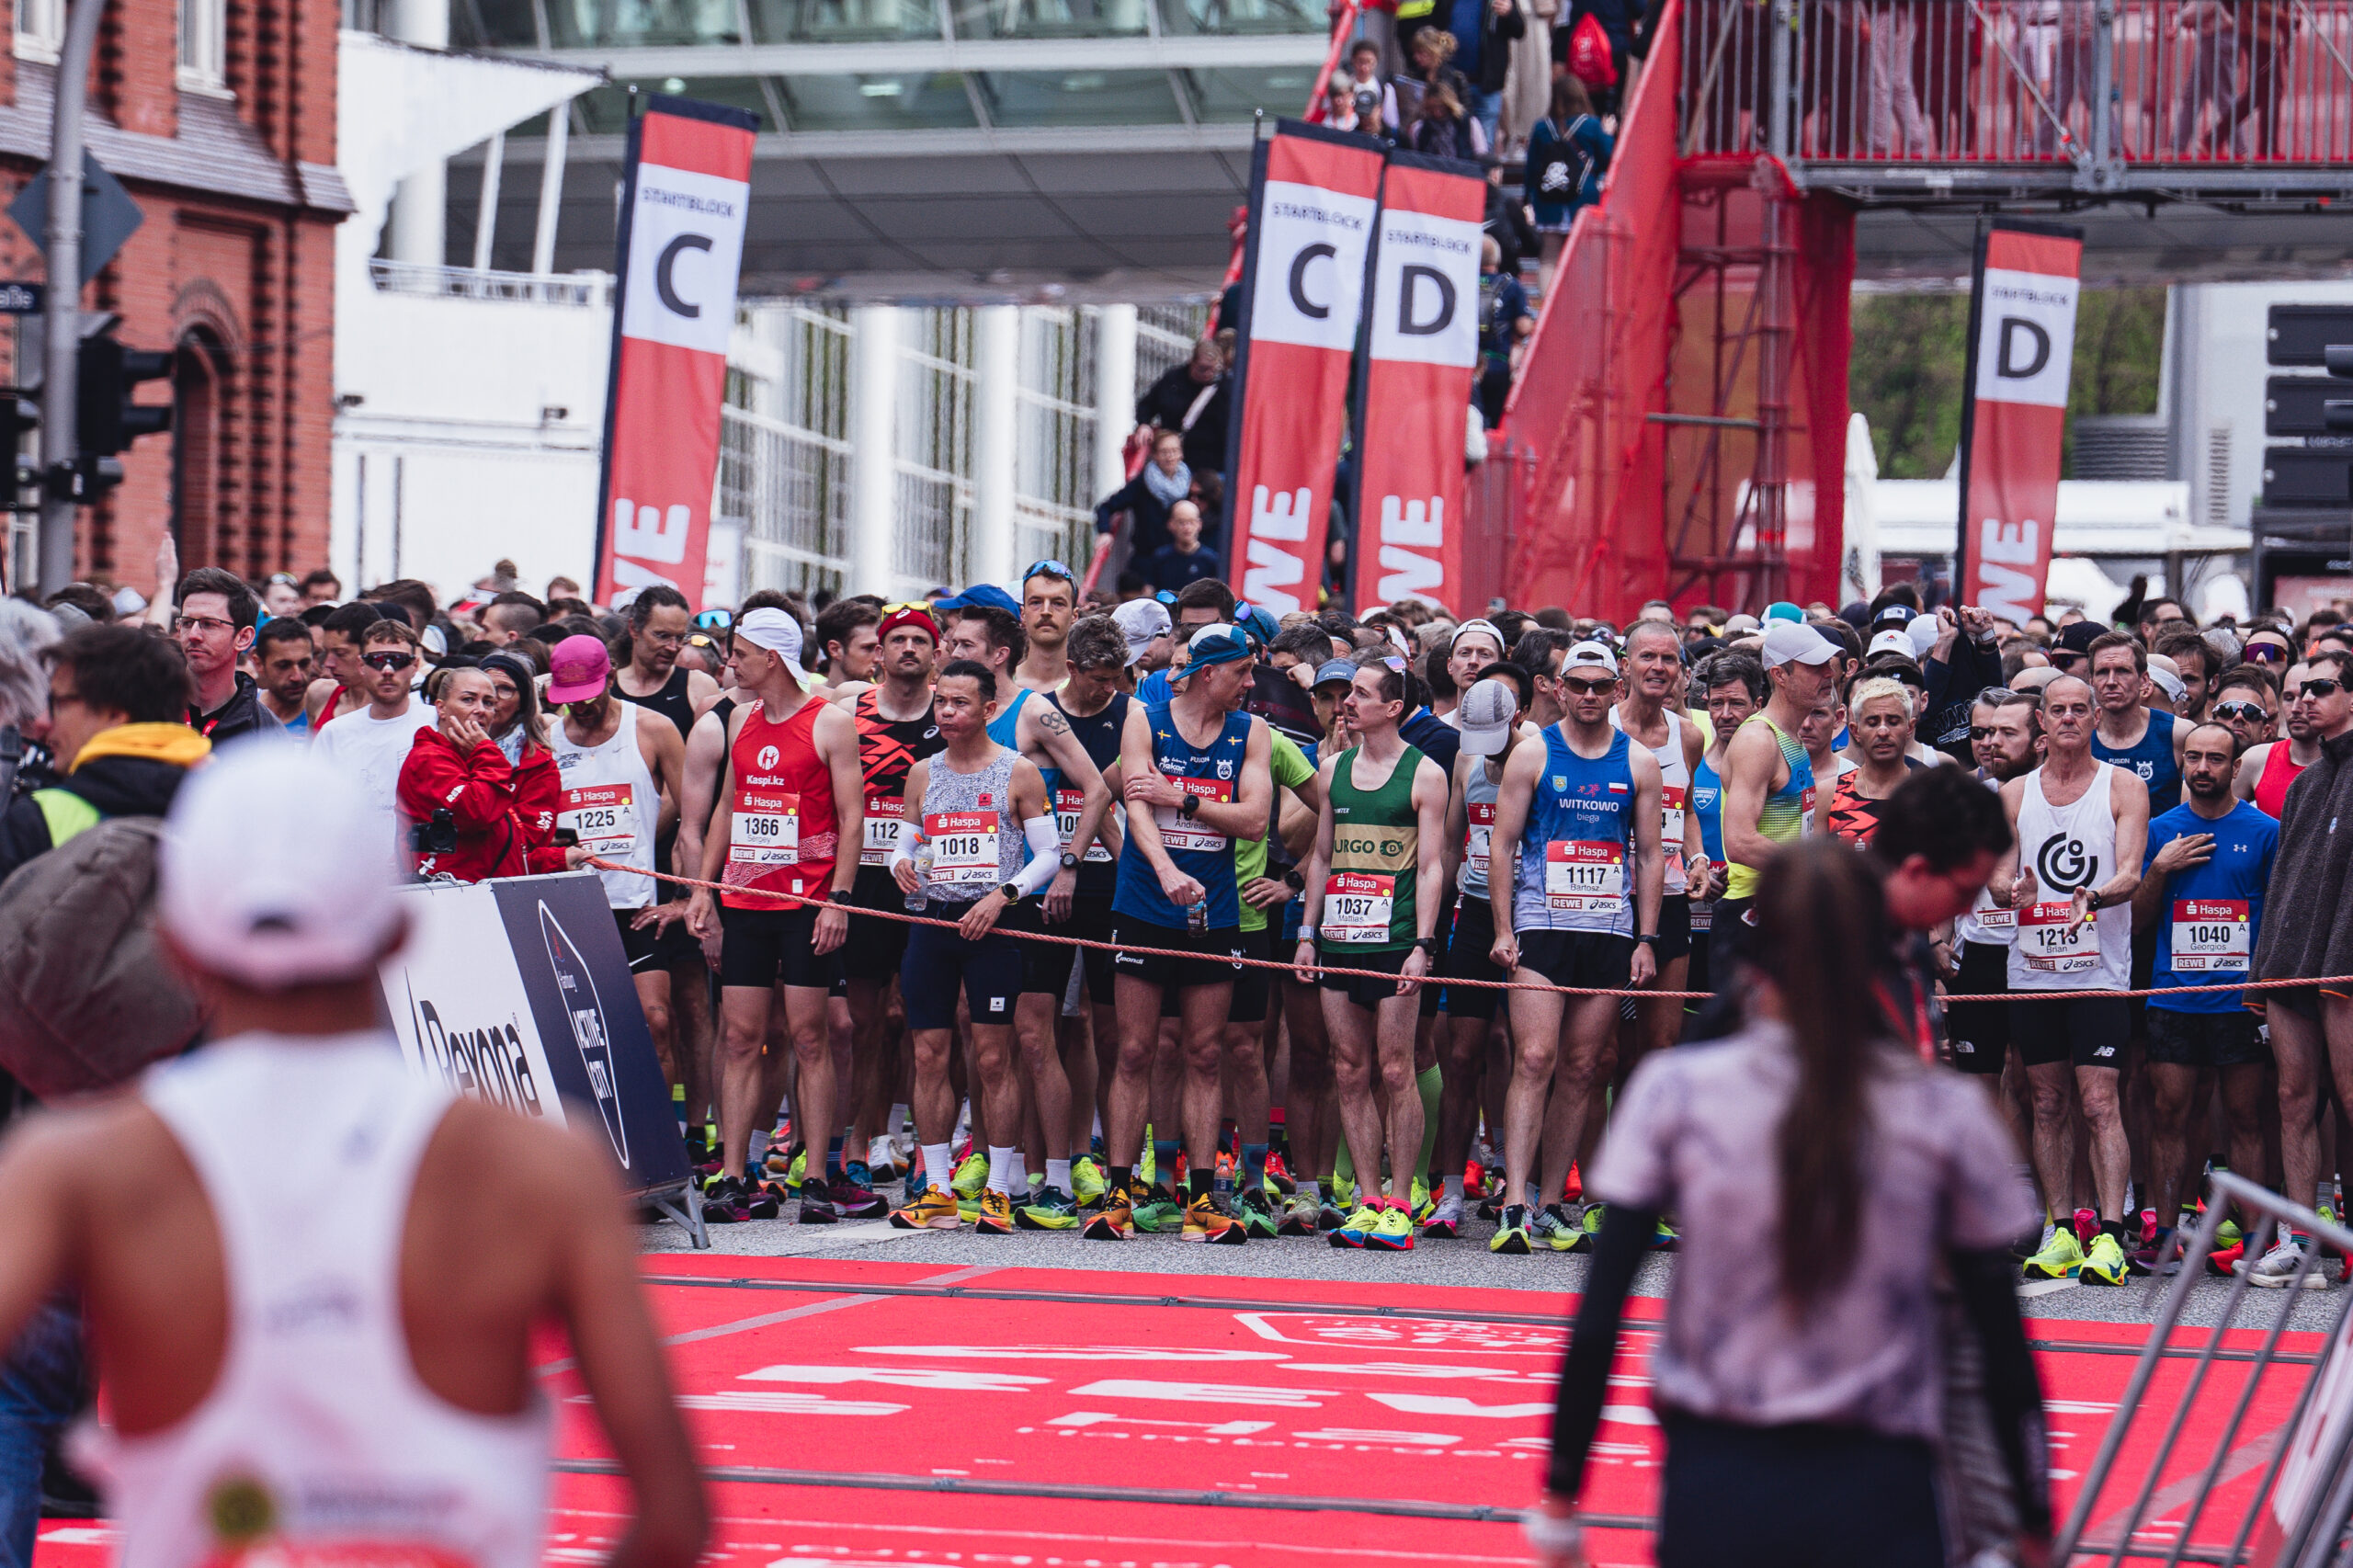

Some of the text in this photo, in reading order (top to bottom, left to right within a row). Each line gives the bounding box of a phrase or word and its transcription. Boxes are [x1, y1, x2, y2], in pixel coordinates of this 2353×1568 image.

[1272, 202, 1364, 231] STARTBLOCK
[1386, 229, 1472, 255] STARTBLOCK
[656, 233, 714, 318] C
[1289, 243, 1337, 319] C
[1398, 265, 1456, 335] D
[1997, 317, 2051, 379] D
[745, 774, 785, 787] Kaspi.kz
[1187, 782, 1217, 796] Haspa
[583, 790, 616, 802] Haspa
[1066, 794, 1084, 805] Has
[754, 797, 782, 809] Haspa
[881, 802, 904, 813] Hasp
[1559, 798, 1620, 812] WITKOWO
[623, 806, 631, 814] A
[1674, 811, 1680, 819] A
[574, 810, 615, 829] 1225
[787, 817, 794, 825] A
[949, 817, 981, 828] Haspa
[1576, 812, 1600, 824] biega
[745, 817, 779, 836] 1366
[870, 822, 899, 840] 112
[987, 835, 995, 843] A
[939, 837, 980, 856] 1018
[1334, 838, 1376, 854] URGO
[1578, 845, 1608, 858] Haspa
[937, 854, 980, 863] Yerkebulan
[1566, 866, 1607, 885] 1117
[1613, 866, 1620, 874] A
[1346, 877, 1378, 890] Haspa
[1570, 883, 1600, 892] Bartosz
[1336, 898, 1373, 915] 1037
[1381, 898, 1389, 906] A
[1552, 898, 1582, 908] REWE
[2046, 907, 2070, 917] Hasp
[2200, 904, 2233, 917] Haspa
[1984, 914, 2010, 925] REWE
[2086, 924, 2095, 932] A
[2239, 924, 2246, 932] A
[1324, 930, 1347, 940] REWE
[2188, 926, 2231, 943] 1040
[2046, 946, 2068, 954] Brian
[2190, 942, 2227, 952] Georgios
[2030, 960, 2055, 970] REWE
[2177, 959, 2205, 968] REWE
[419, 999, 544, 1116] Rexona
